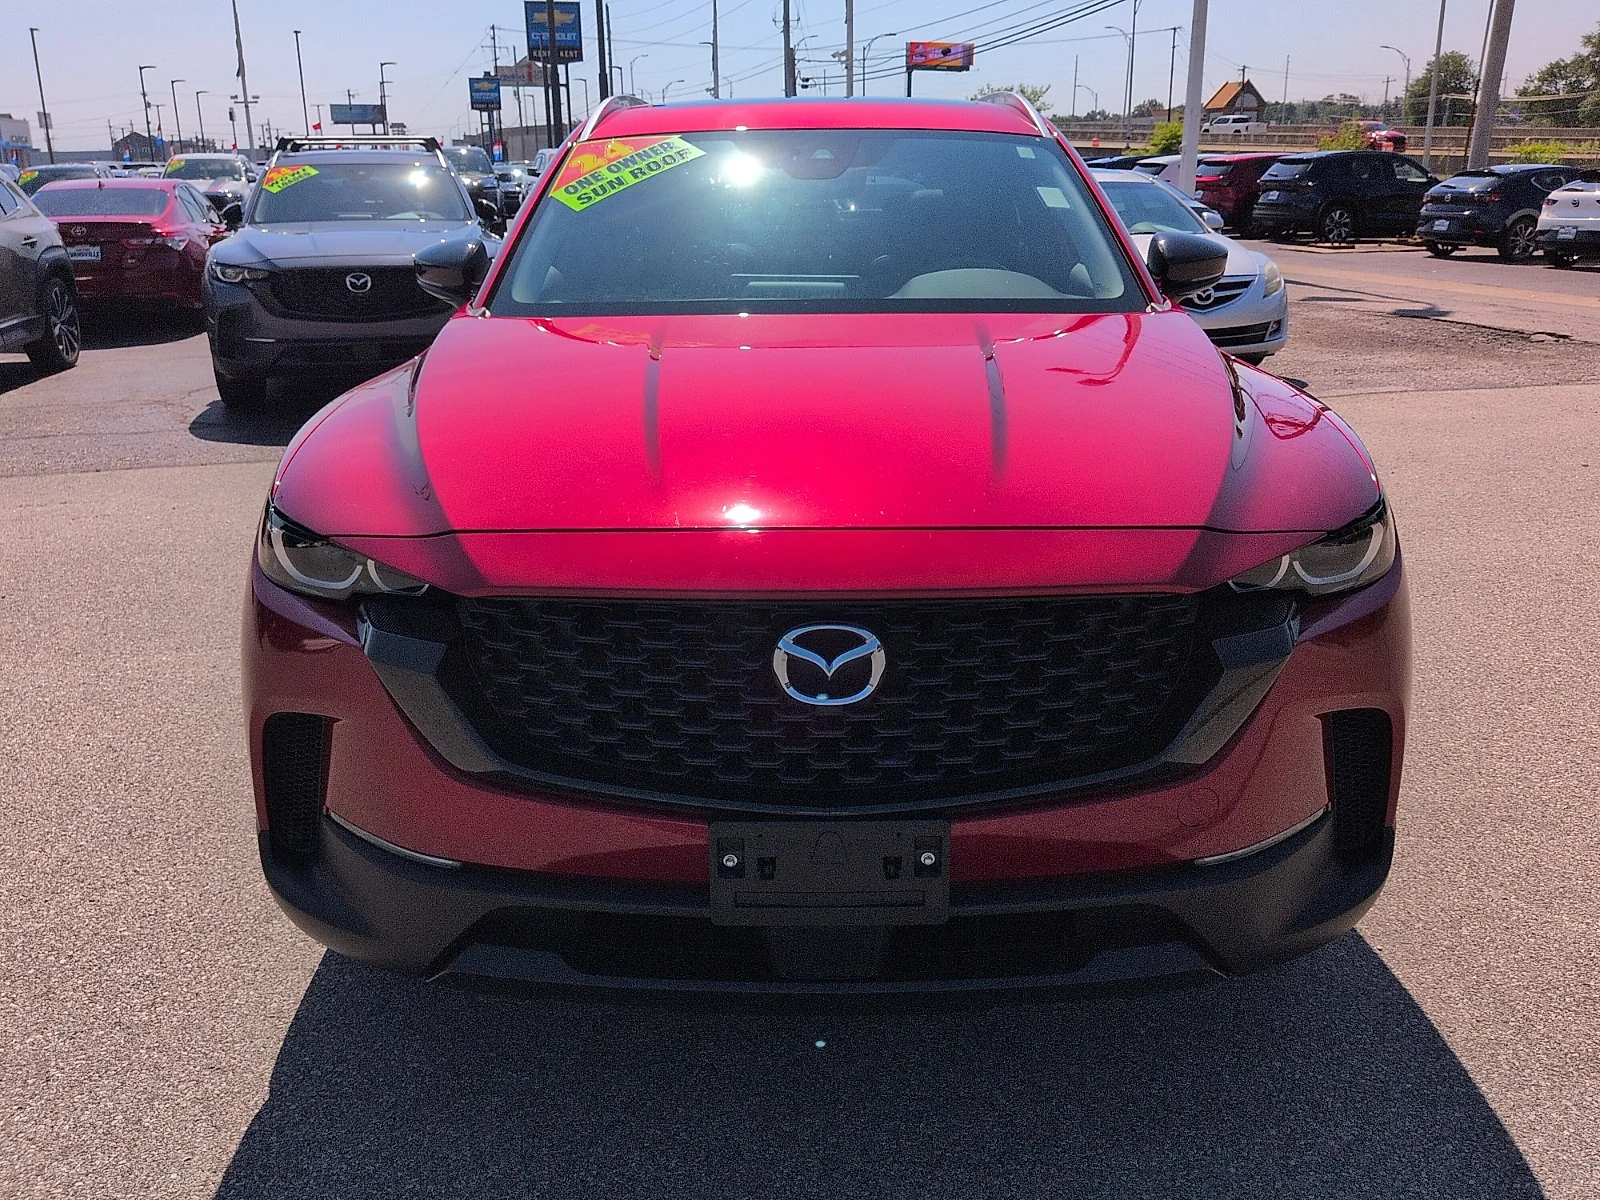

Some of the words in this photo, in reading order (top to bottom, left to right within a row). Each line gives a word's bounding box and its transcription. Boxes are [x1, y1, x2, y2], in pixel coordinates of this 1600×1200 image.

[564, 171, 605, 195] ONE
[606, 141, 676, 174] OWNER
[569, 141, 633, 173] 24
[576, 176, 625, 205] SUN
[629, 149, 690, 180] ROOF
